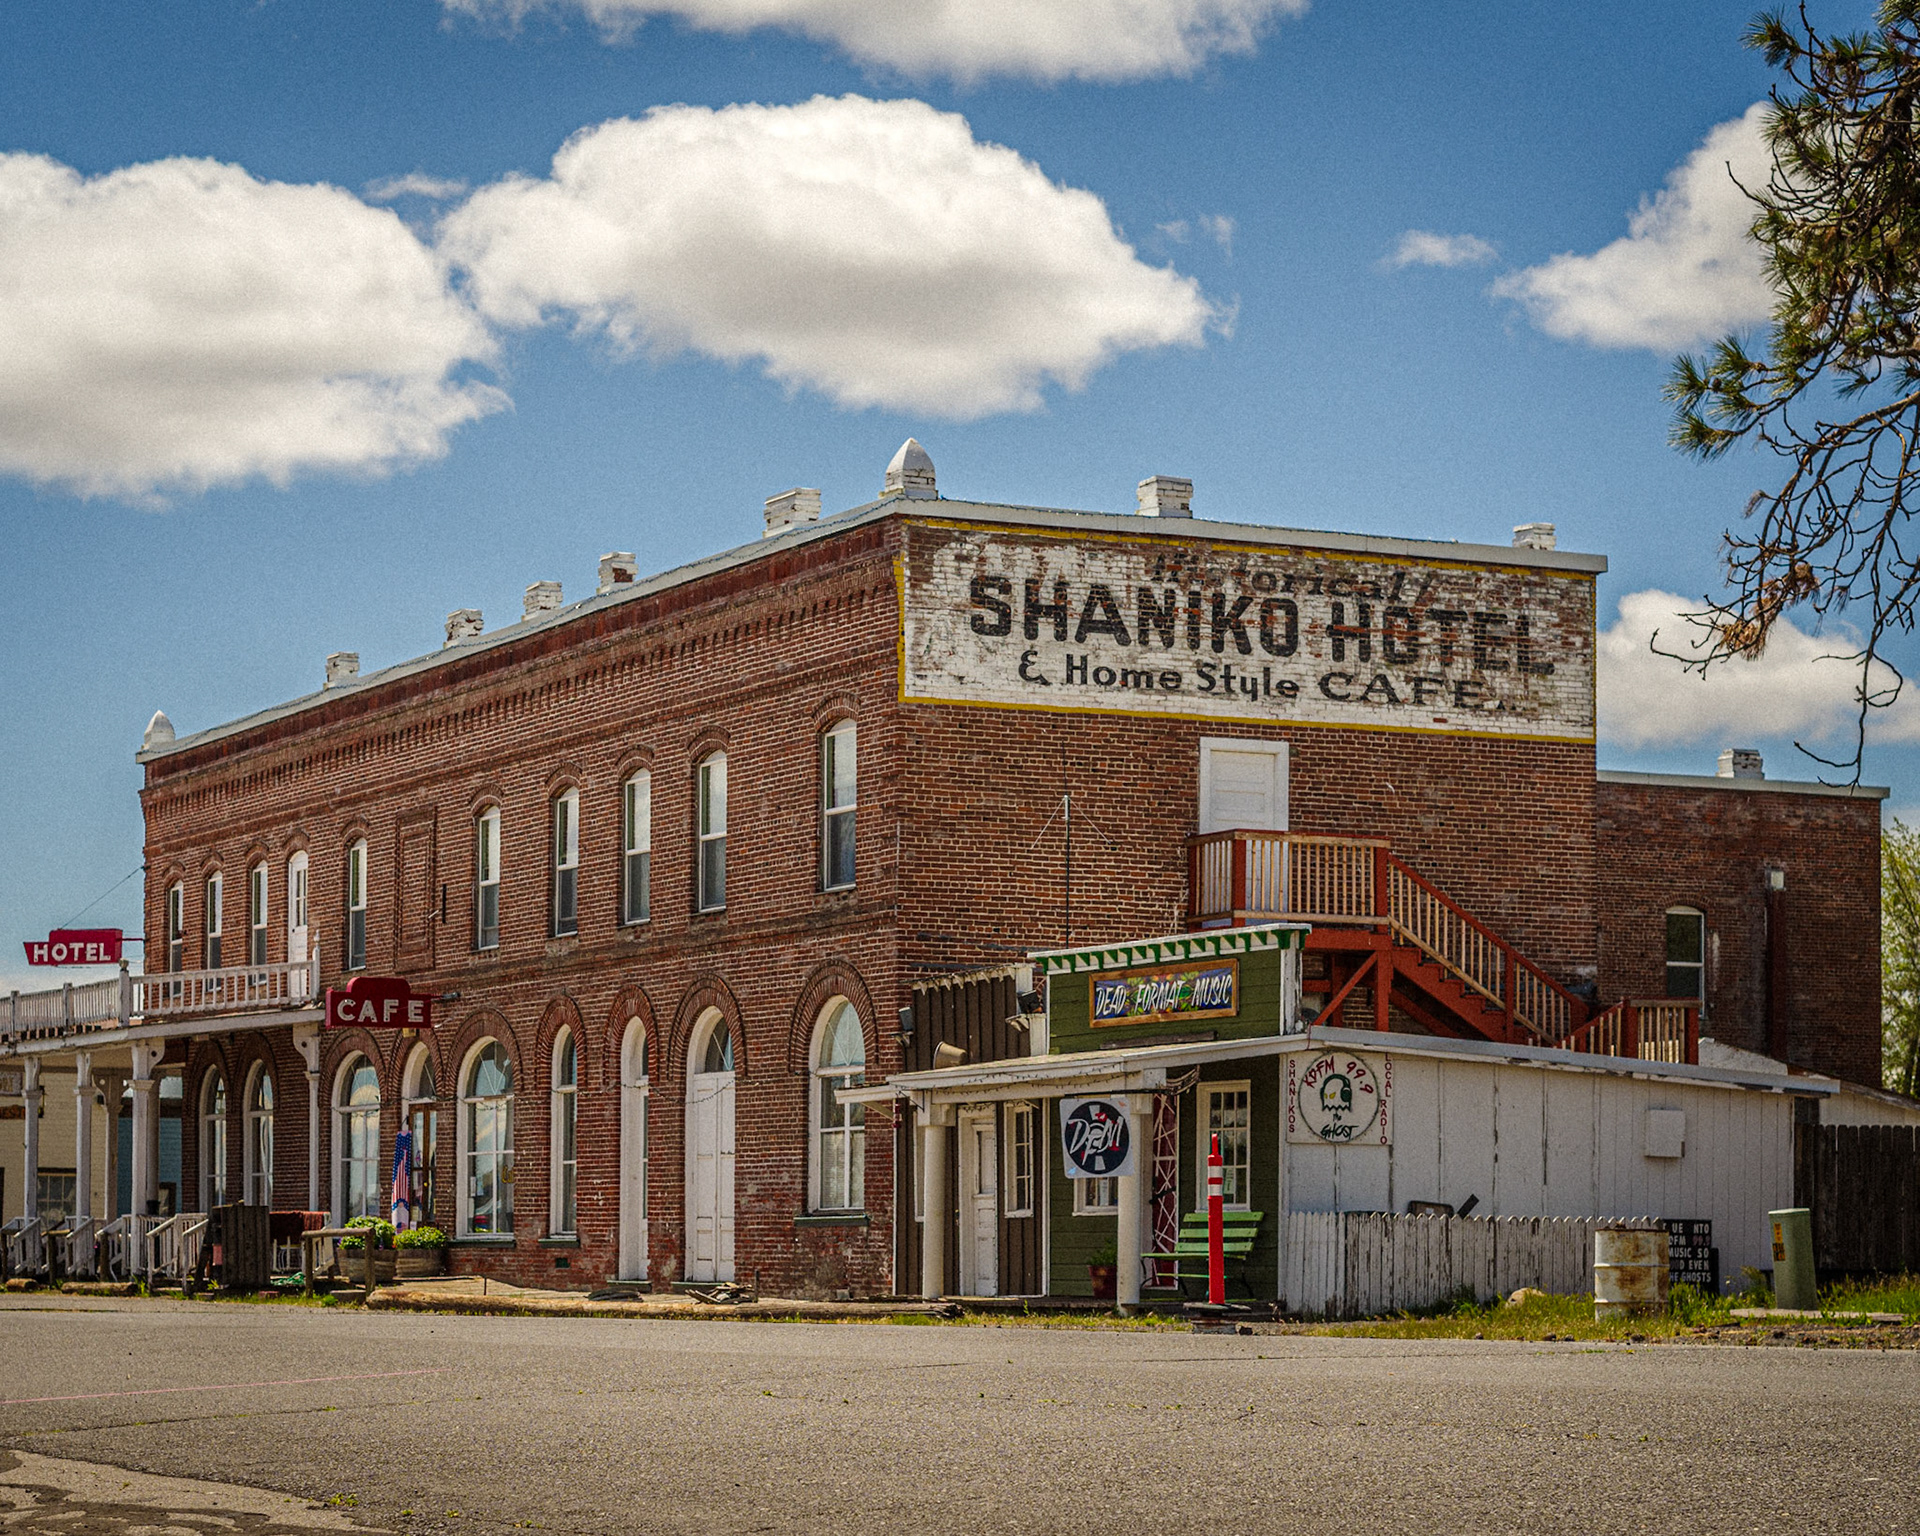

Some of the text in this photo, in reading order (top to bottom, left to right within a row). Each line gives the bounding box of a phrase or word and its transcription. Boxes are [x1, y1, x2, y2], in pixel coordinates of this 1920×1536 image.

[970, 575, 1555, 676] SHANIKO HOTEL
[1018, 650, 1485, 710] & Home Style CAFE
[33, 942, 112, 963] HOTEL
[336, 998, 425, 1023] CAFE
[1095, 974, 1233, 1016] DEAD FORMAT MUSIC
[1303, 1055, 1375, 1094] KDFM 99.9
[1384, 1052, 1392, 1098] LOCAL
[1288, 1059, 1296, 1133] SHANIKOS
[1320, 1122, 1360, 1140] GHOST
[1380, 1099, 1388, 1145] RADIO
[1688, 1259, 1710, 1271] EVEN
[1696, 1247, 1710, 1259] SO
[1681, 1271, 1712, 1283] GHOSTS
